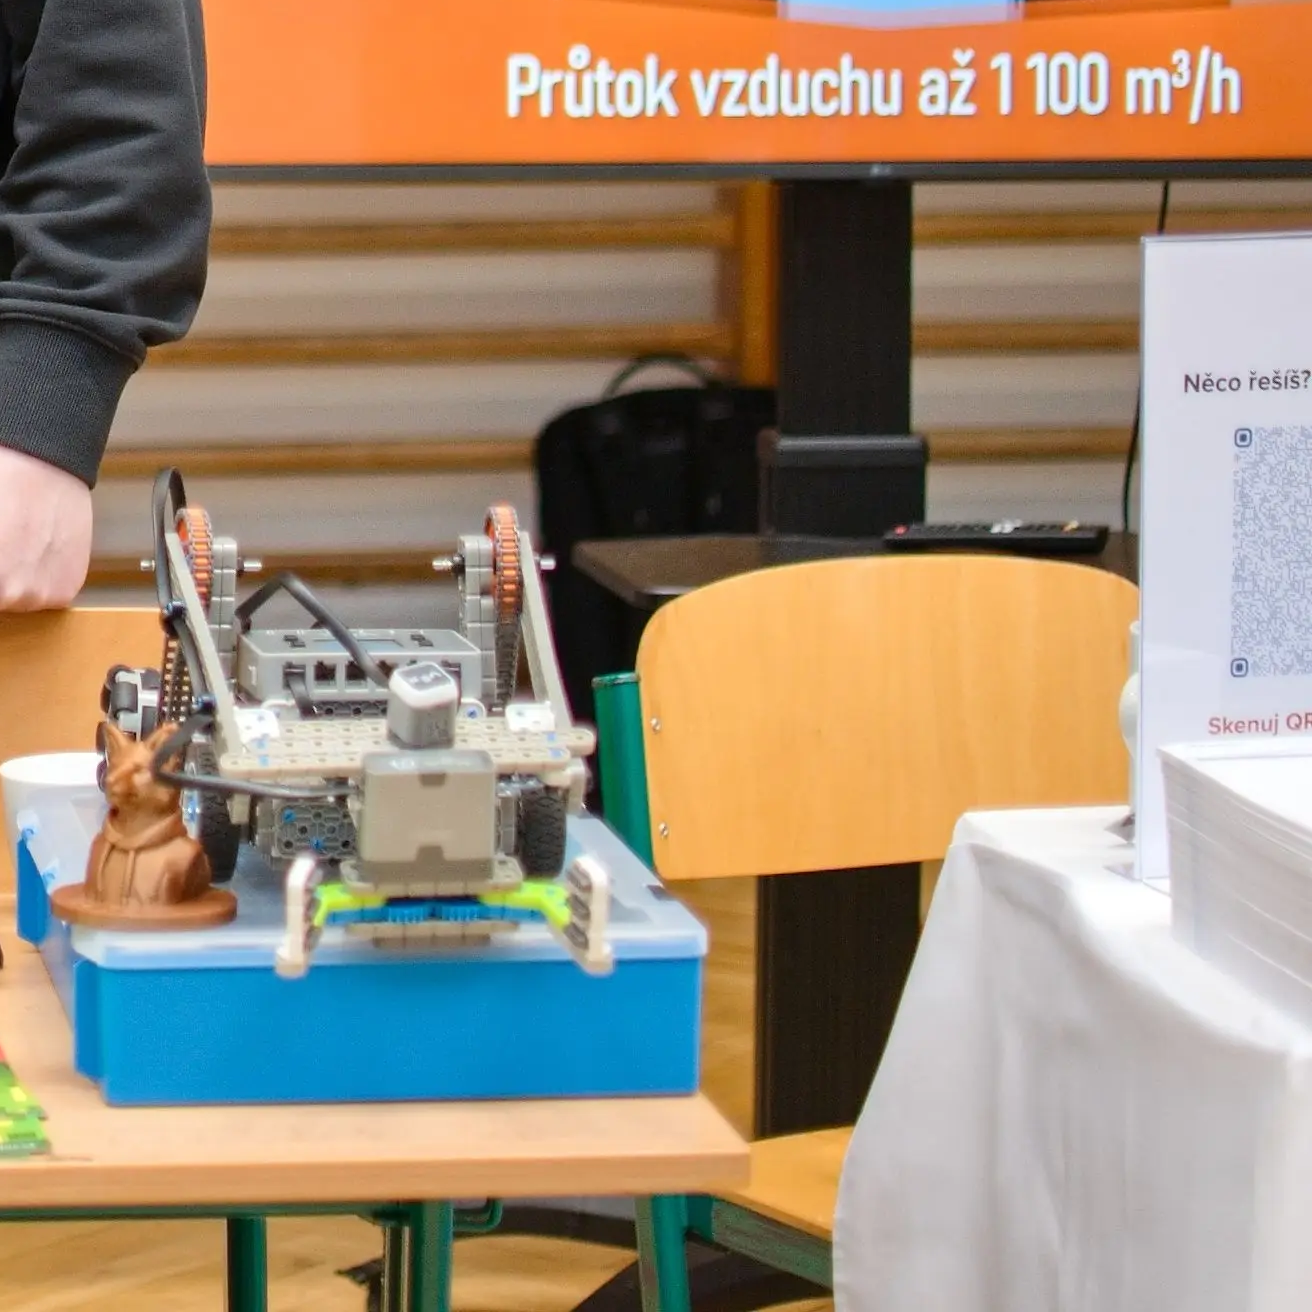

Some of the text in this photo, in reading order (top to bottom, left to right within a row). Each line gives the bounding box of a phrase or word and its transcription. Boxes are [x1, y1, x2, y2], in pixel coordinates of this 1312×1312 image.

[506, 43, 680, 119] Průtok
[689, 51, 904, 118] vzduchu
[918, 47, 977, 116] až
[1183, 368, 1312, 394] Něco řešíš?
[1208, 713, 1279, 736] Skenuj
